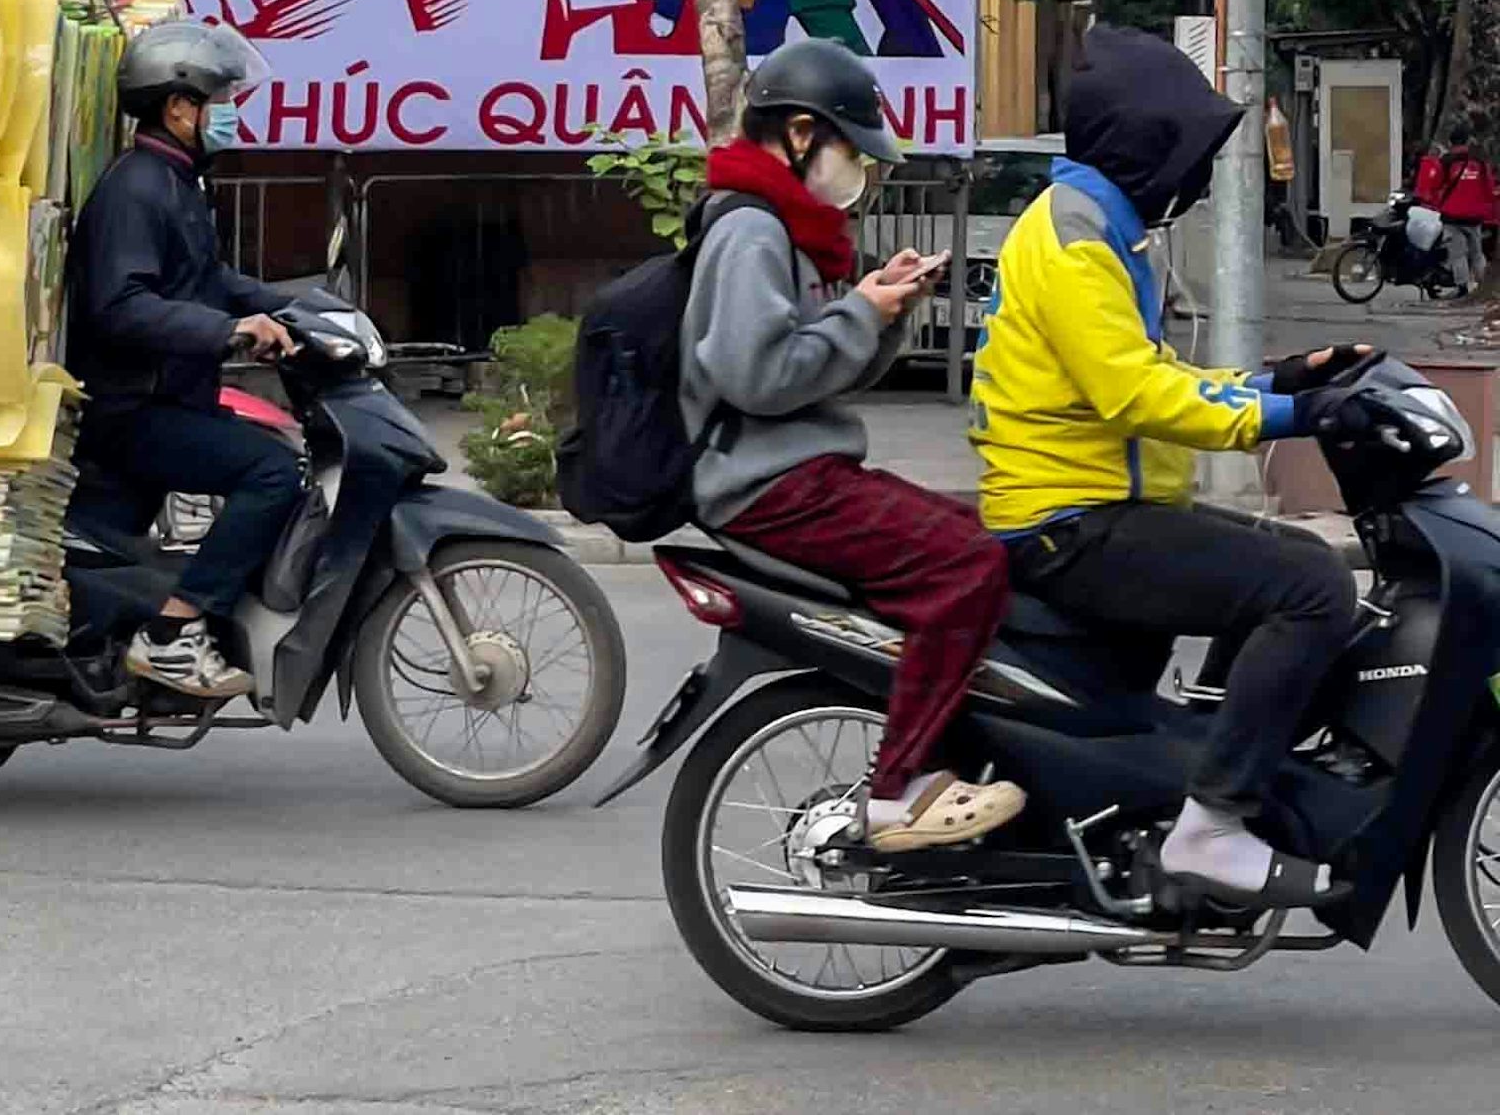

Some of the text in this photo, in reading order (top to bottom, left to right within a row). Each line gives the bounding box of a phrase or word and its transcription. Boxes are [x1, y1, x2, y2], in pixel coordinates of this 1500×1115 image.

[479, 68, 709, 146] QUÂN
[880, 85, 967, 145] NH
[1358, 664, 1428, 682] HONDA
